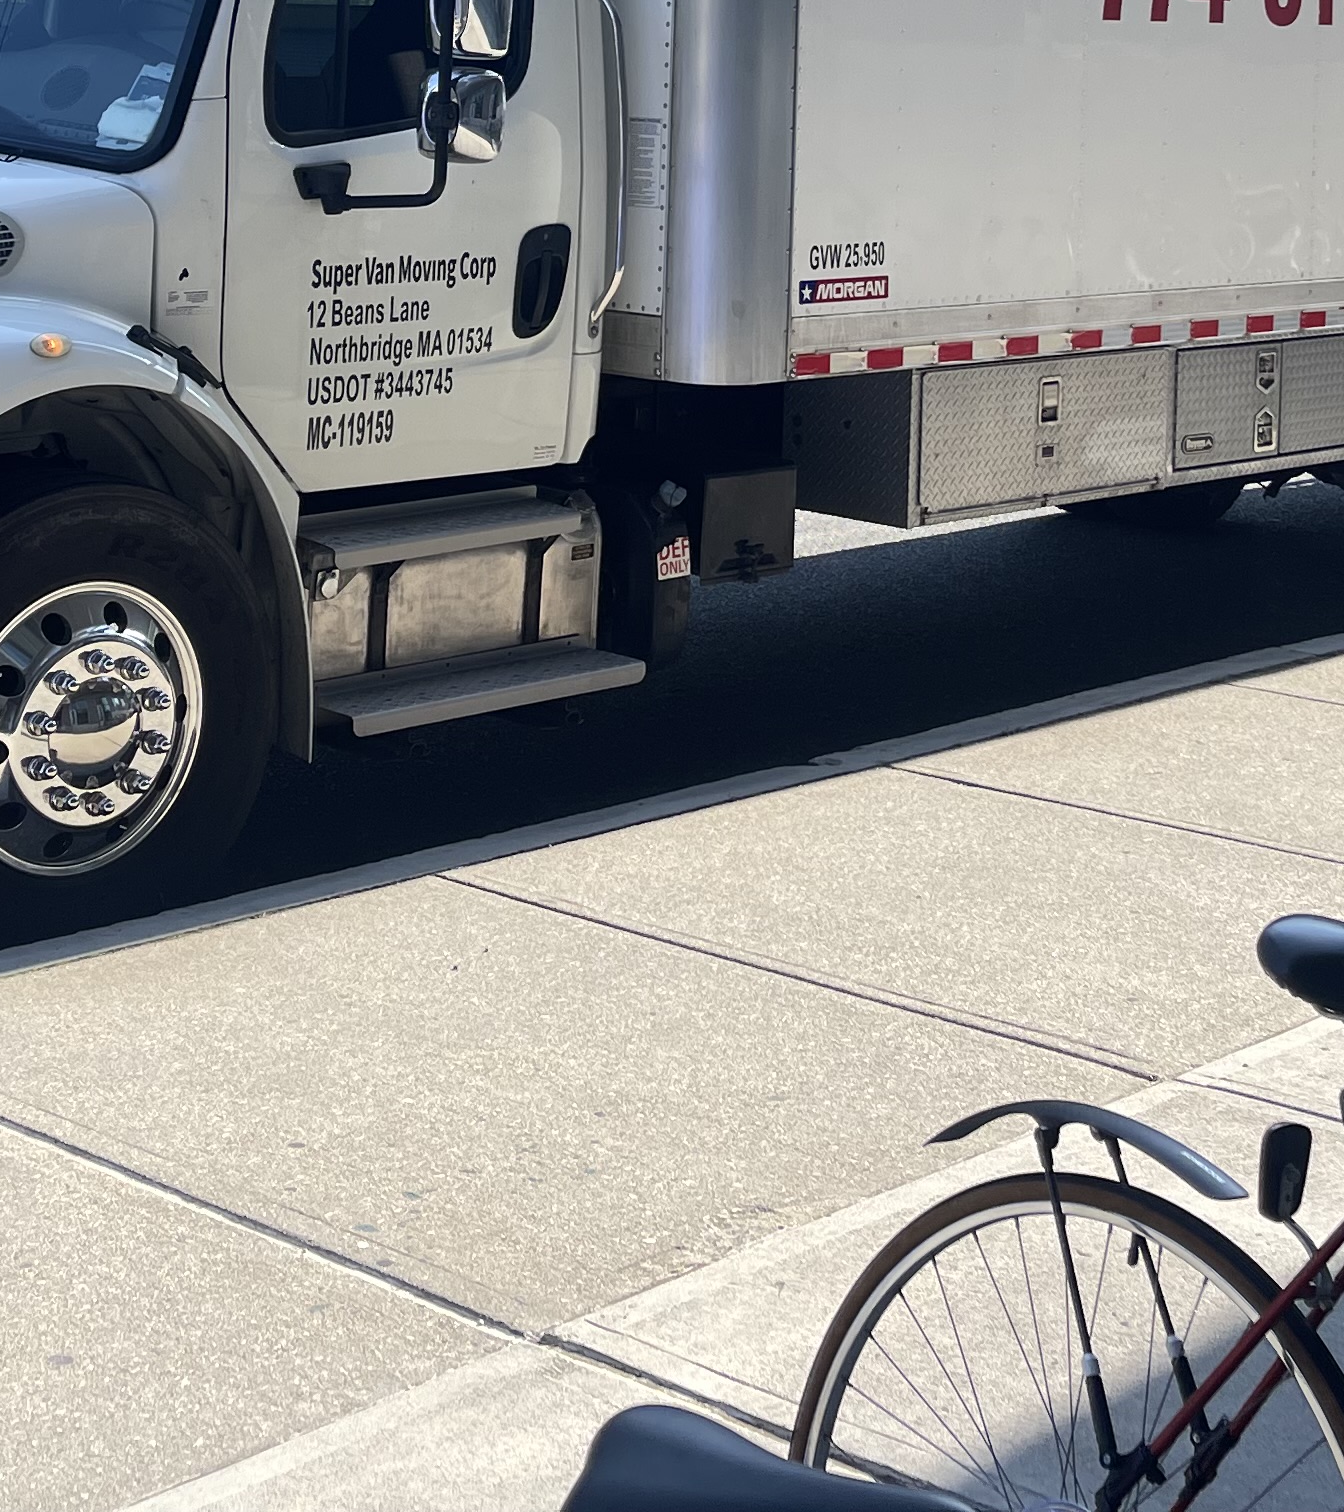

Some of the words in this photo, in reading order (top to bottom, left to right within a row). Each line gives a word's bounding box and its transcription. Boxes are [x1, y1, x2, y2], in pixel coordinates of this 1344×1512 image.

[311, 259, 362, 293] Super
[365, 257, 395, 285] Van
[399, 255, 456, 288] Moving
[460, 252, 496, 284] Corp
[810, 244, 842, 270] GVW
[845, 241, 885, 268] 25,950
[816, 280, 886, 300] MORGAN
[307, 301, 326, 328] 12
[332, 299, 384, 326] Beans
[390, 296, 429, 322] Lane
[309, 333, 412, 366] Northbridge
[417, 330, 443, 357] MA
[447, 326, 493, 356] 01534
[308, 374, 370, 405] USDOT
[374, 368, 453, 400] #3443745
[306, 409, 394, 450] MC-119159
[660, 559, 690, 576] ONLY
